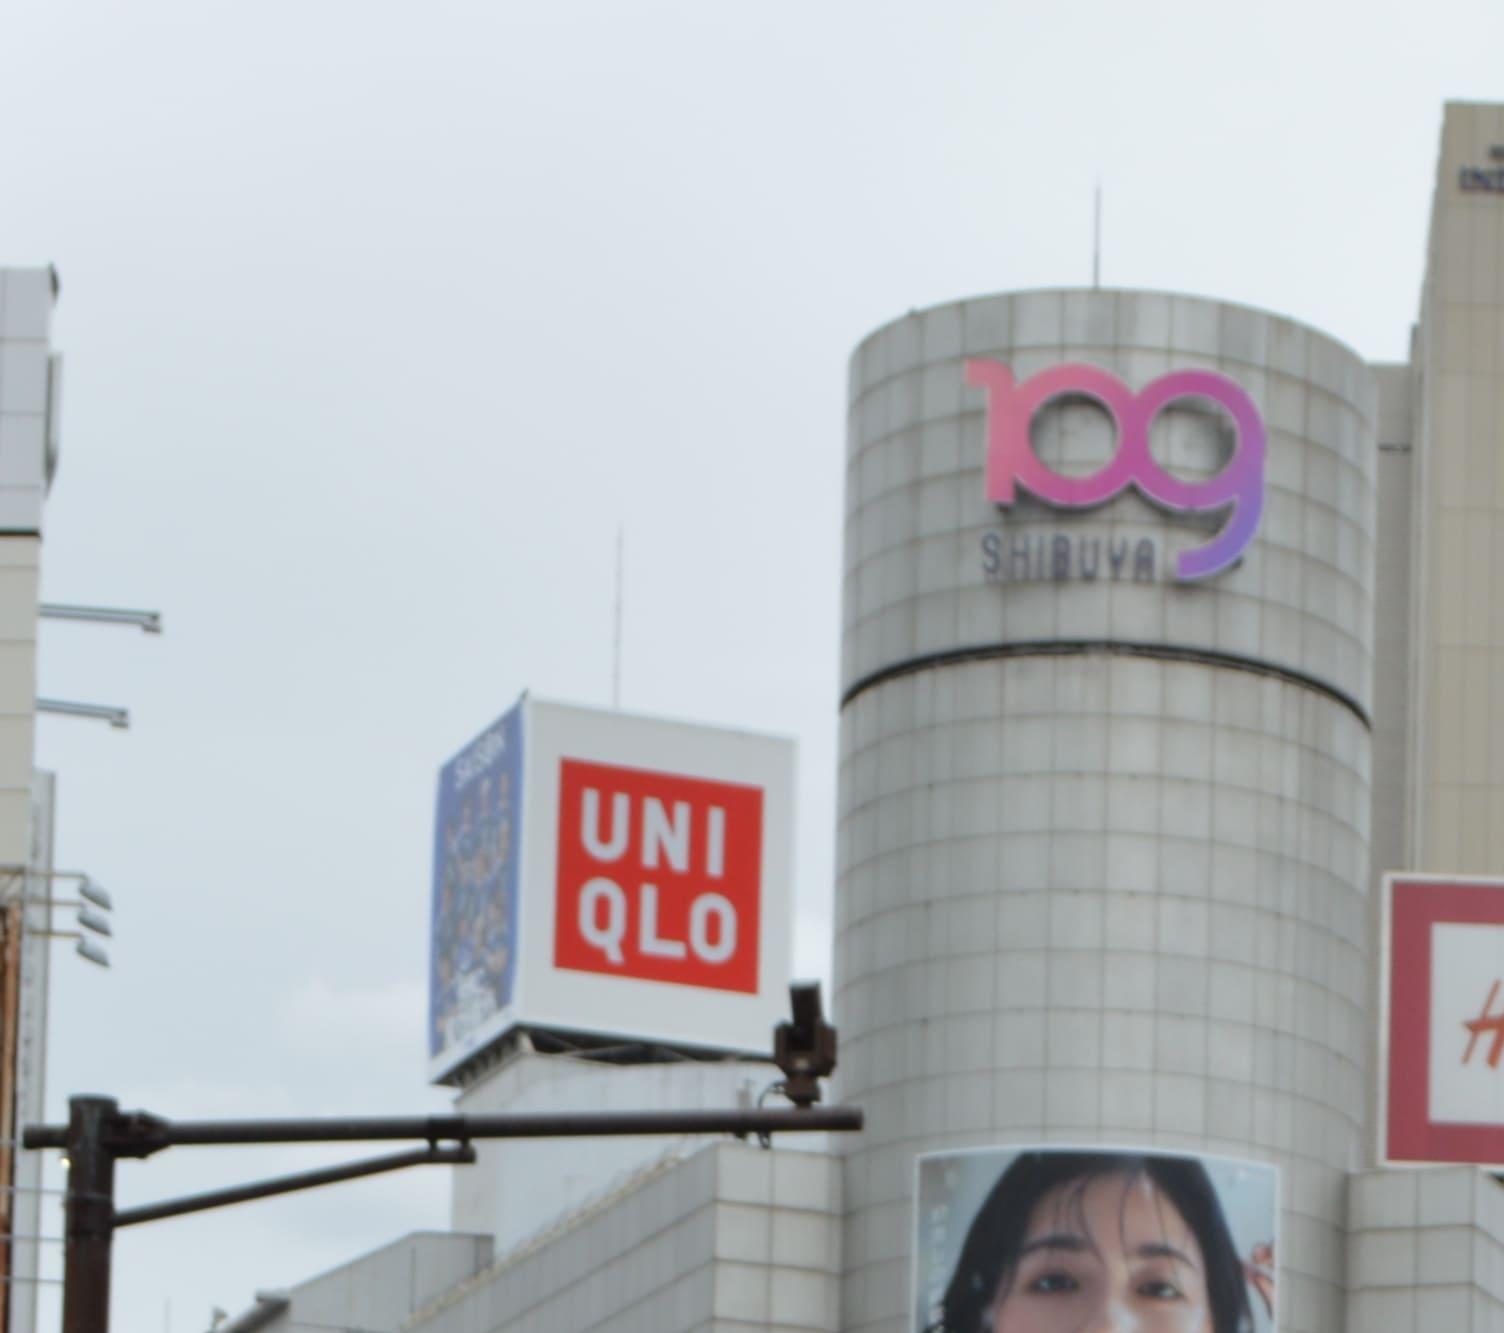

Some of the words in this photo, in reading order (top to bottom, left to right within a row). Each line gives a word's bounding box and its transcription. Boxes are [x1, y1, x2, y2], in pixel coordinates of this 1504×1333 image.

[964, 360, 1266, 580] 109
[982, 532, 1156, 580] SHIBUYA
[580, 788, 727, 873] UNI
[577, 878, 739, 965] QLO
